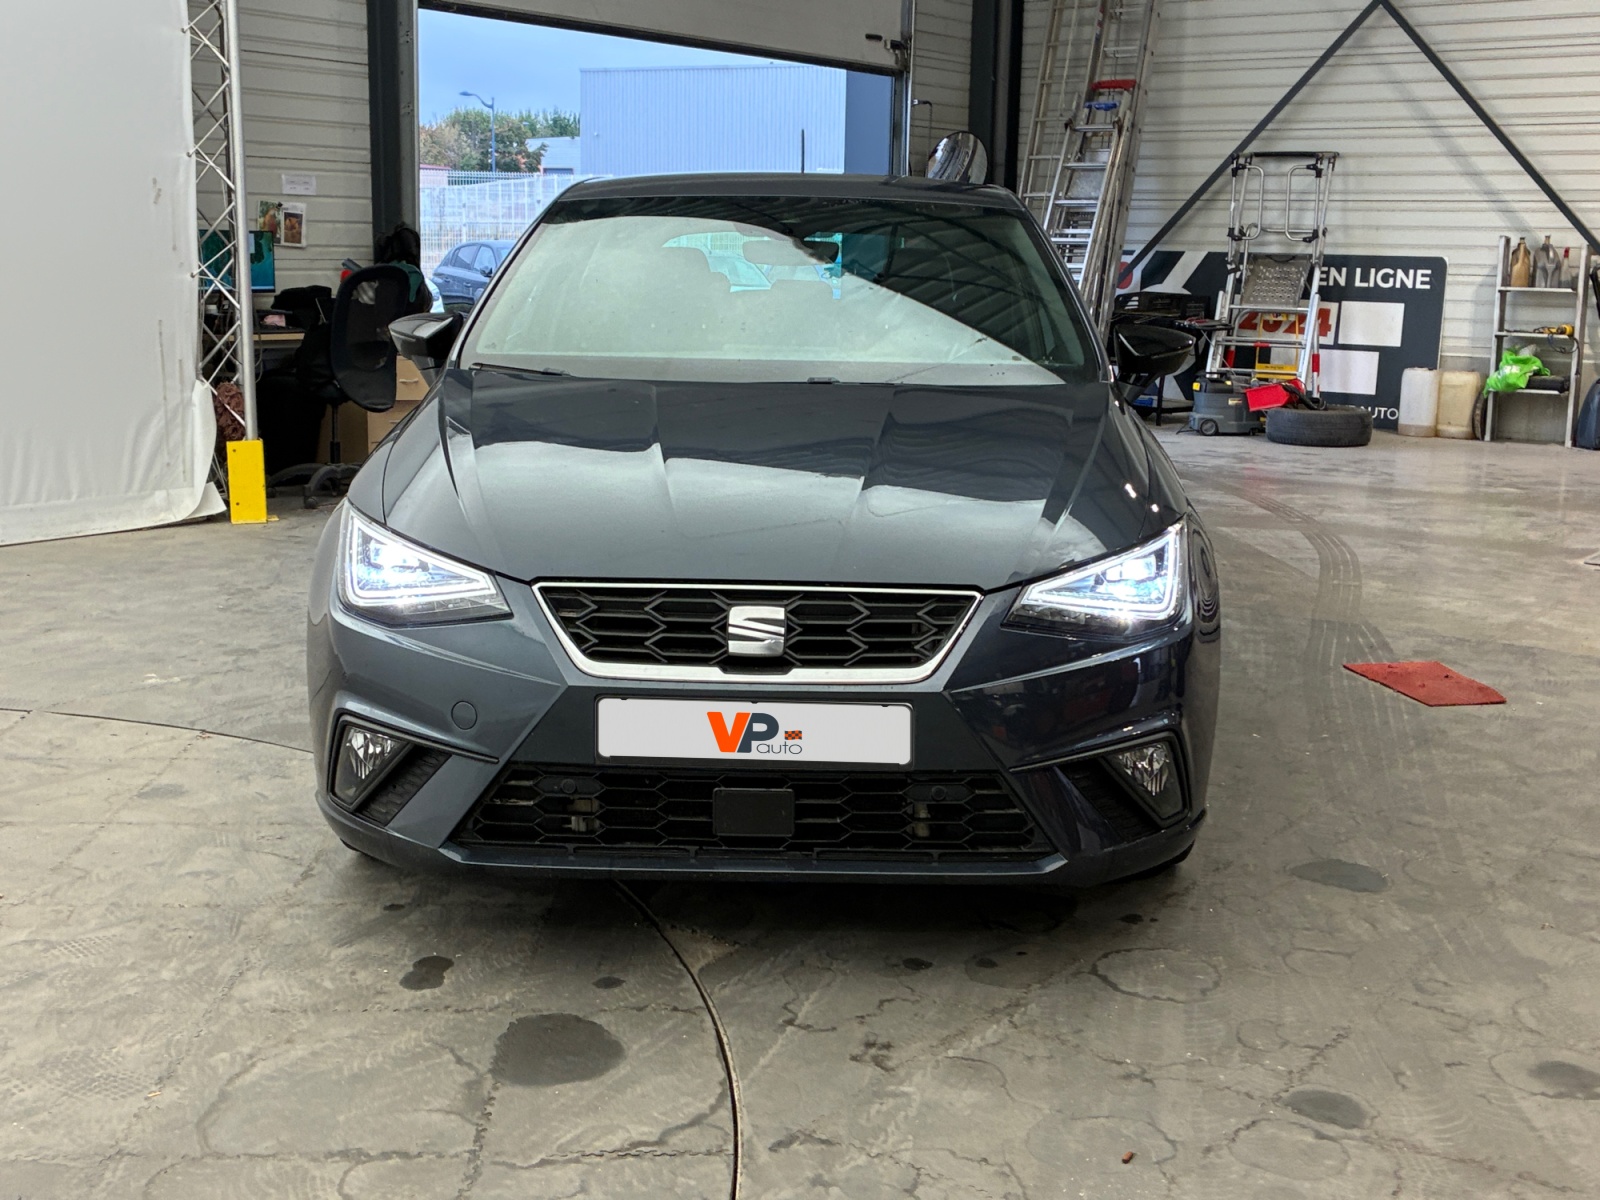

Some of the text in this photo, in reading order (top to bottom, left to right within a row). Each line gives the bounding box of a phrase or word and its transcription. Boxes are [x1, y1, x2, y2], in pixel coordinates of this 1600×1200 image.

[1318, 266, 1432, 290] EN LIGNE
[1360, 405, 1399, 420] UTO
[707, 711, 803, 755] VP auto
